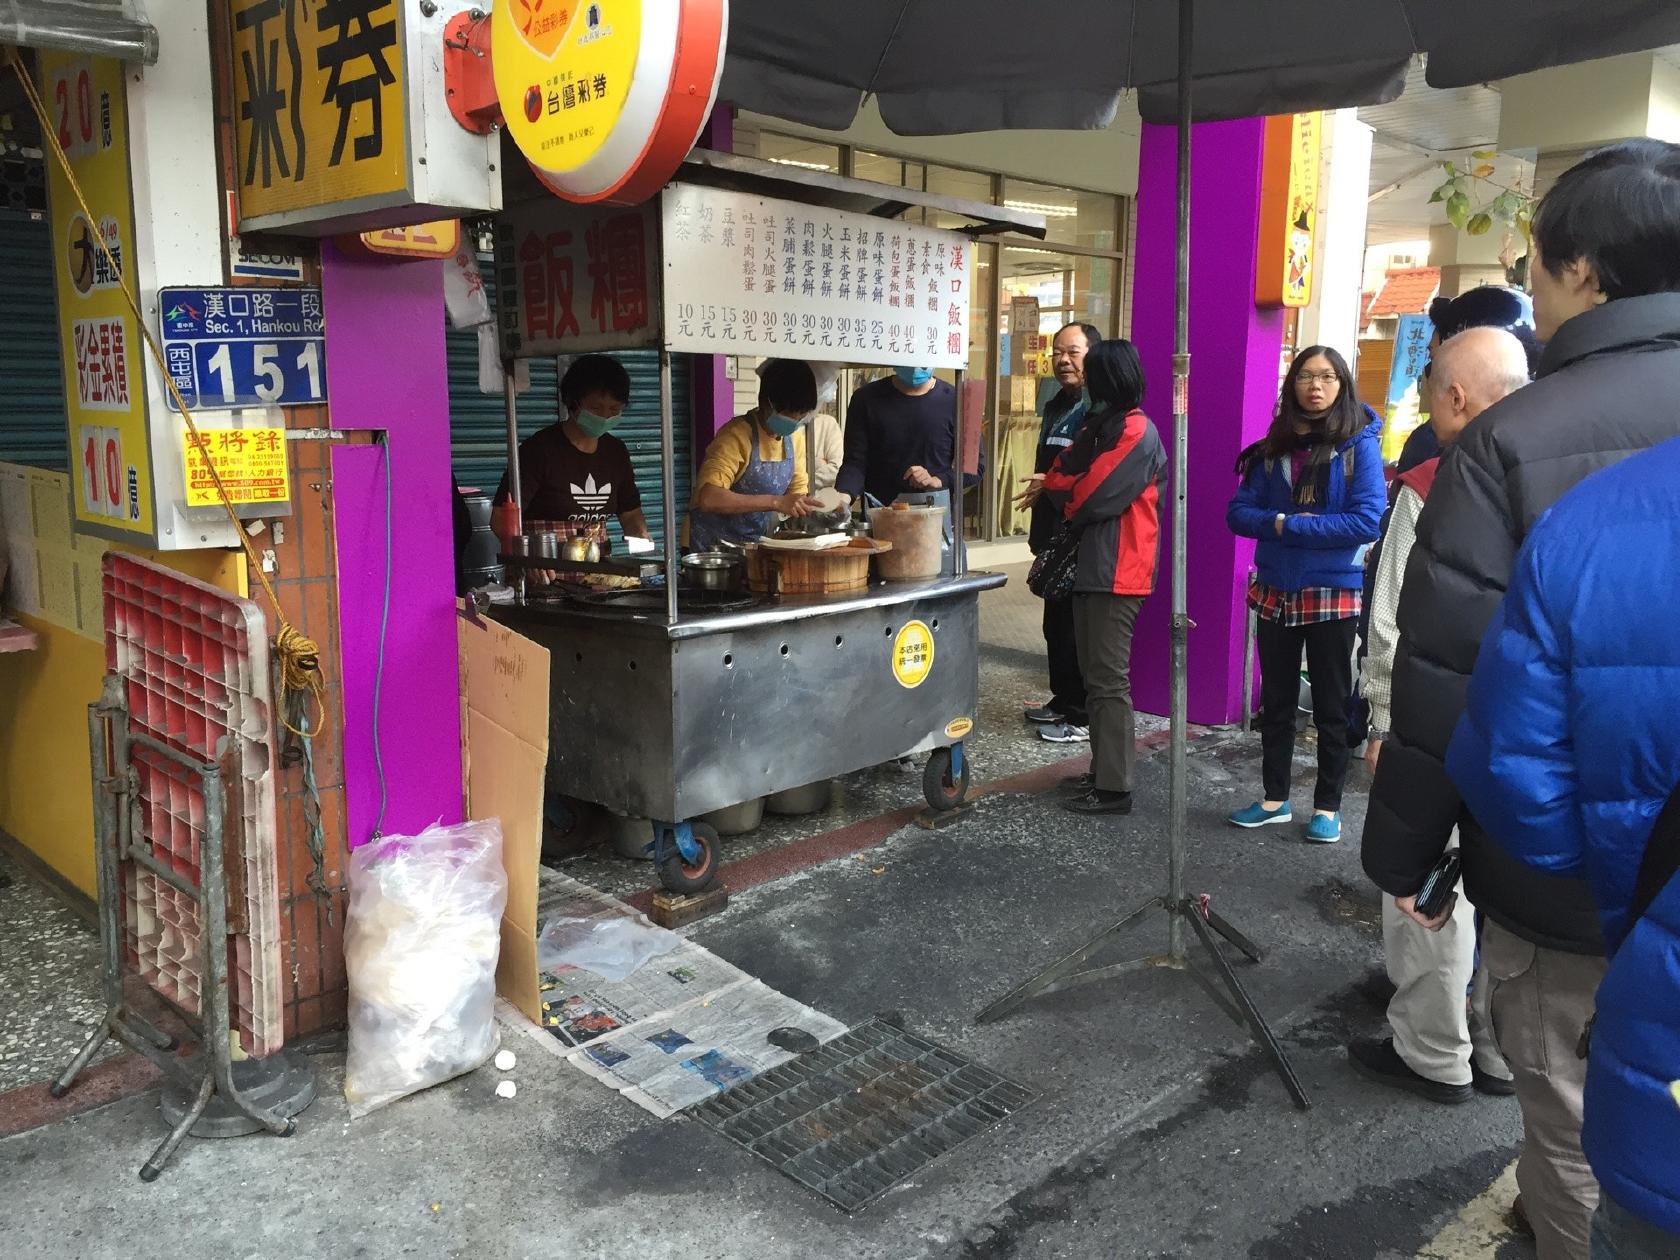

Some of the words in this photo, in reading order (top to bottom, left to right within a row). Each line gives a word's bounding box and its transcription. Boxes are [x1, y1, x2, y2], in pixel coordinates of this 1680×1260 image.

[56, 69, 92, 149] 20
[236, 0, 396, 188] 彩券
[698, 202, 714, 244] 奶茶
[721, 207, 736, 248] 豆漿
[782, 217, 796, 295] 菜脯蛋餅
[921, 240, 932, 276] 素食
[801, 220, 816, 297] 肉鬆蛋餅
[820, 223, 834, 299] 火腿蛋餅
[838, 227, 851, 301] 玉米蛋餅
[855, 228, 868, 303] 招牌蛋餅
[872, 232, 885, 304] 原味蛋餅
[934, 243, 945, 277] 原味
[204, 292, 322, 318] 漢口路一段
[206, 320, 234, 333] Sec.
[237, 320, 249, 335] 1,
[252, 319, 300, 333] Hankou
[74, 321, 128, 404] 彩金累積
[168, 347, 193, 390] 西屯區
[208, 343, 321, 403] 151
[85, 436, 121, 506] 10
[185, 431, 281, 453] 點將錄
